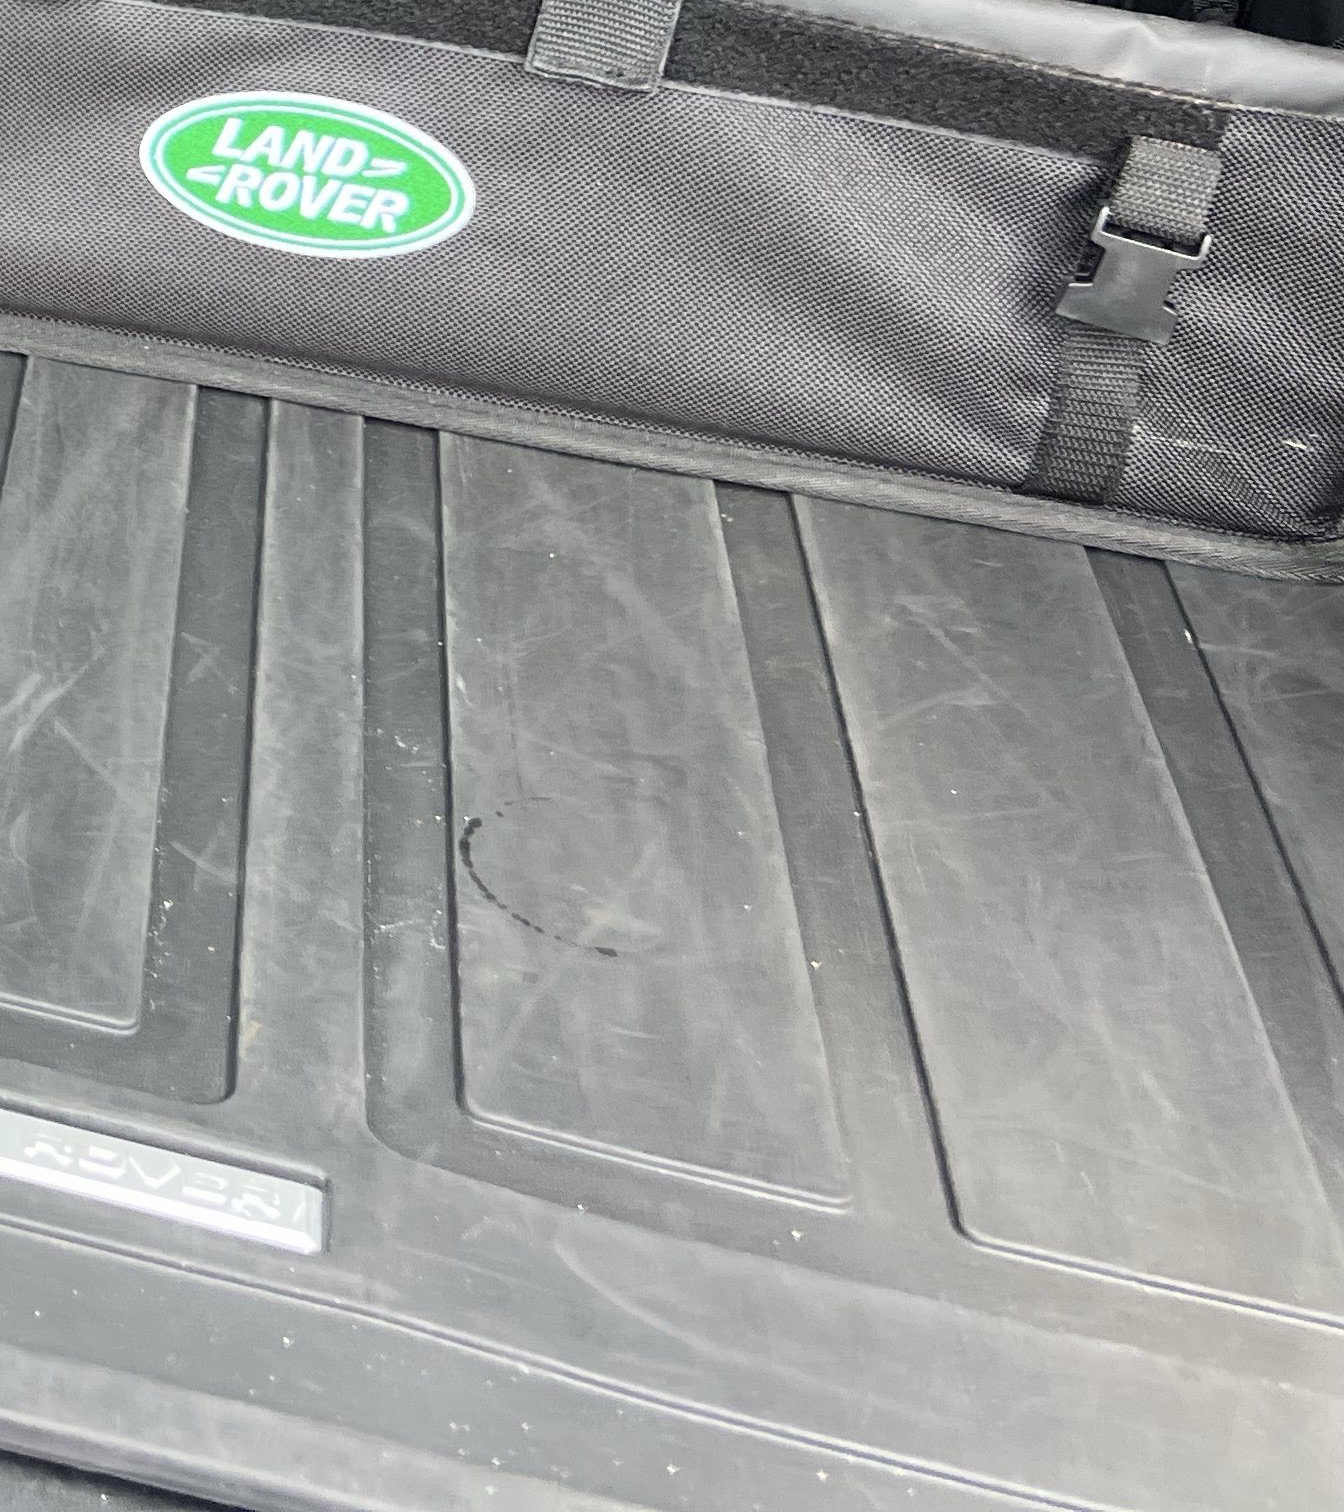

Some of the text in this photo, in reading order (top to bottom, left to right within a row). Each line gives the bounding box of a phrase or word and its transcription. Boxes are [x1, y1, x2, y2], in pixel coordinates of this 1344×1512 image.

[211, 117, 370, 178] LAND
[214, 163, 410, 234] ROVER
[22, 1131, 283, 1221] ROVER
